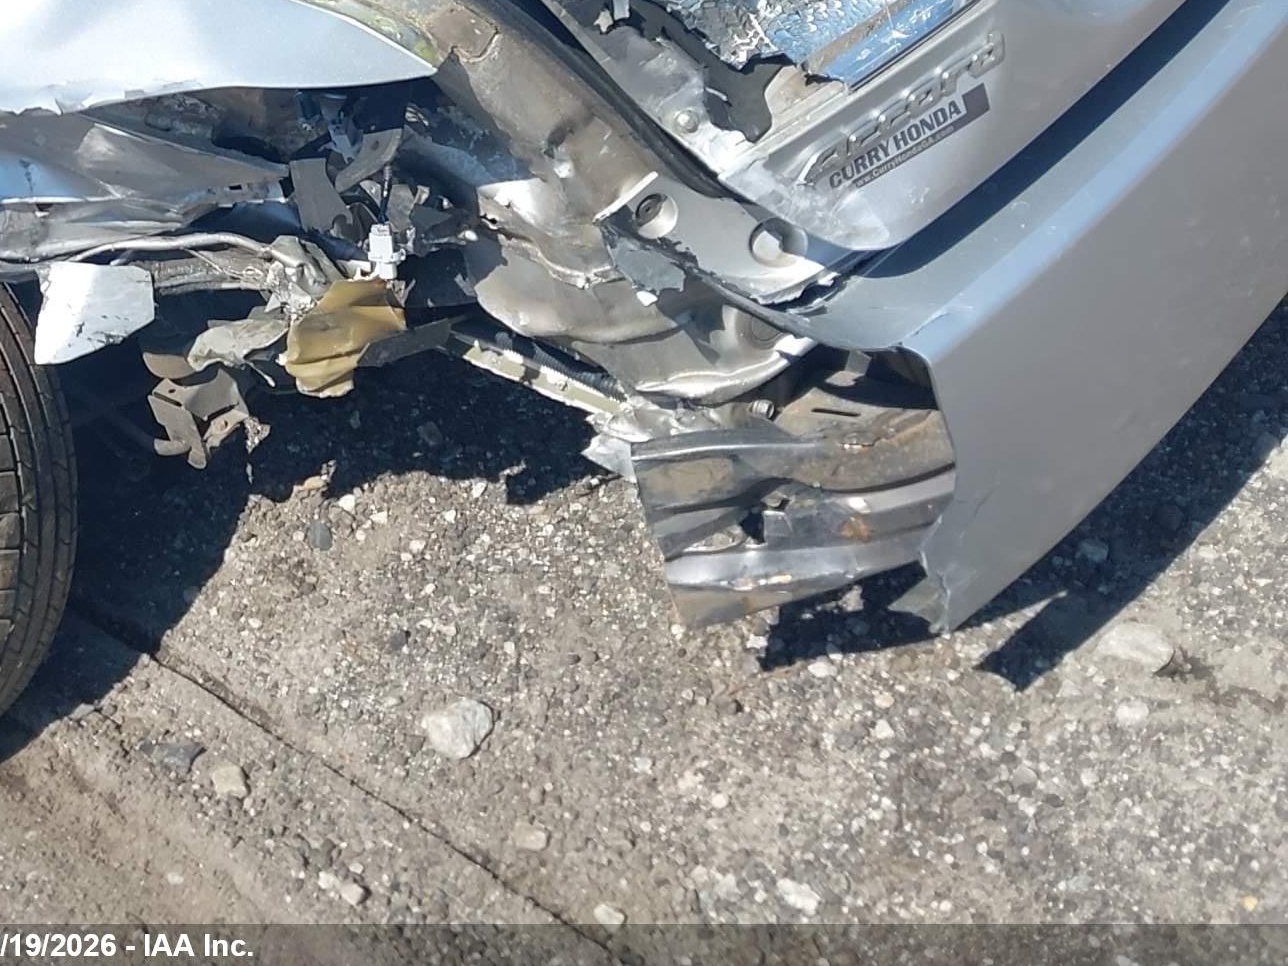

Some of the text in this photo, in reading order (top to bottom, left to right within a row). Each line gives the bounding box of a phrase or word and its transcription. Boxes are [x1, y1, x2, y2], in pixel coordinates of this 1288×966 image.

[829, 100, 962, 189] CURRY HONDA
[850, 125, 955, 189] ww.CurryHondaGA.com
